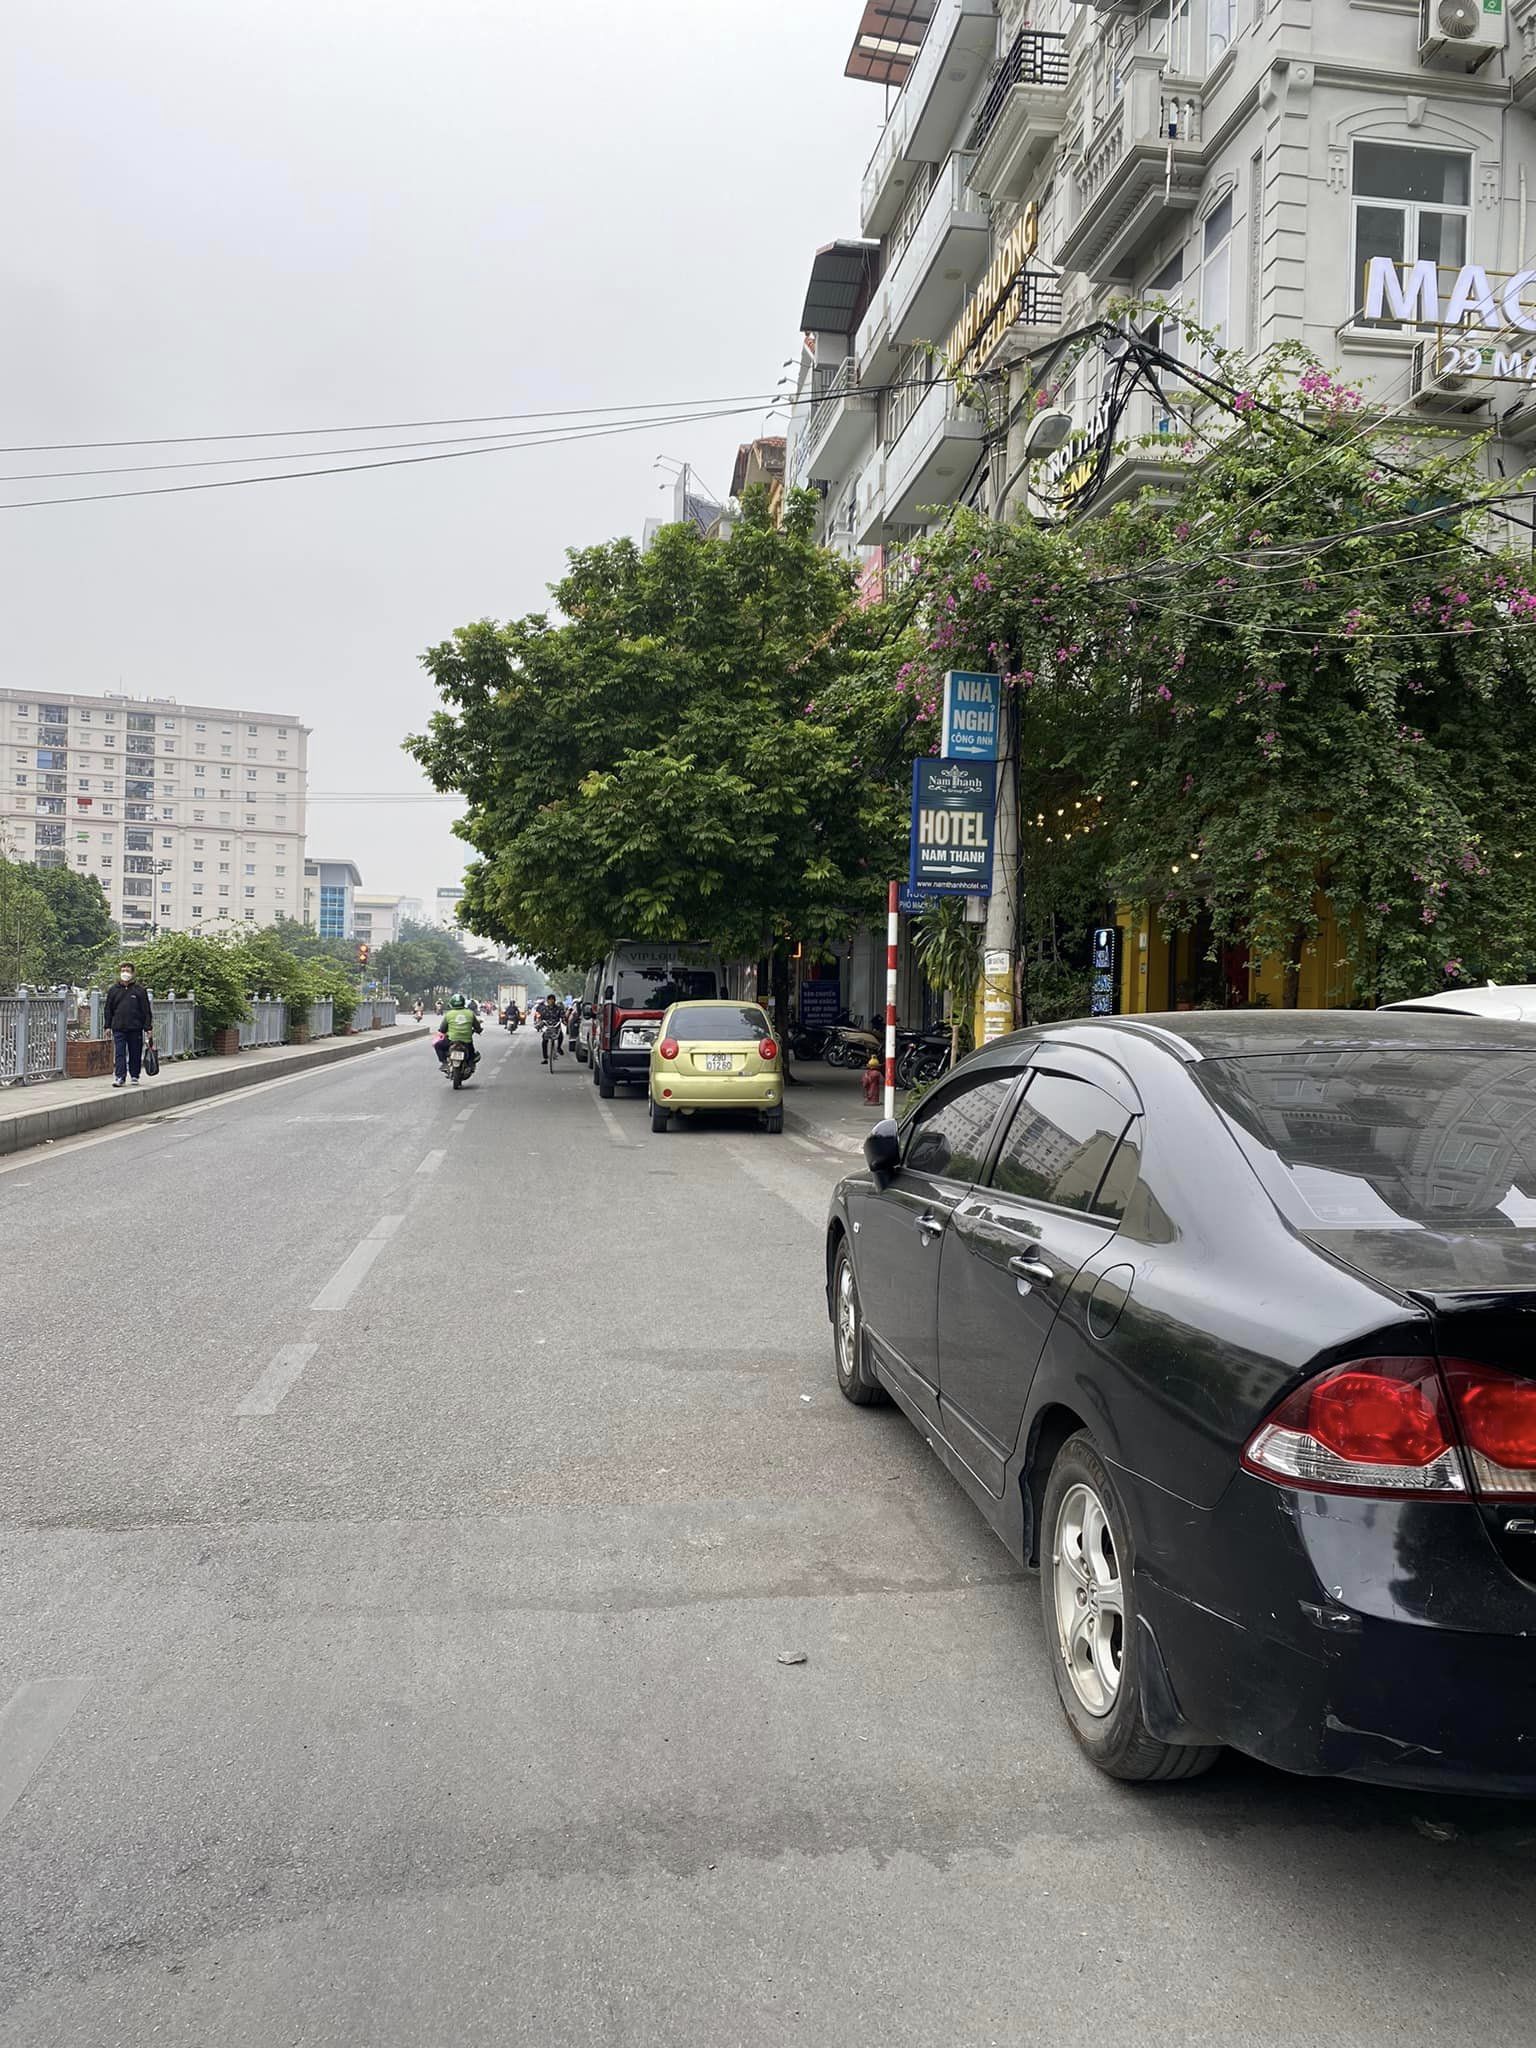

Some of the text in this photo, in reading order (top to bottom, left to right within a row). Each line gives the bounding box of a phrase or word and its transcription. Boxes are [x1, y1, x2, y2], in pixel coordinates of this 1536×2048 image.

[957, 678, 993, 703] NHÀ
[953, 704, 994, 732] NGHỈ
[951, 732, 975, 744] CÔNG
[920, 809, 988, 847] HOTEL
[922, 849, 985, 863] NAM THANH
[917, 880, 988, 889] www.namthanhhotel.vn
